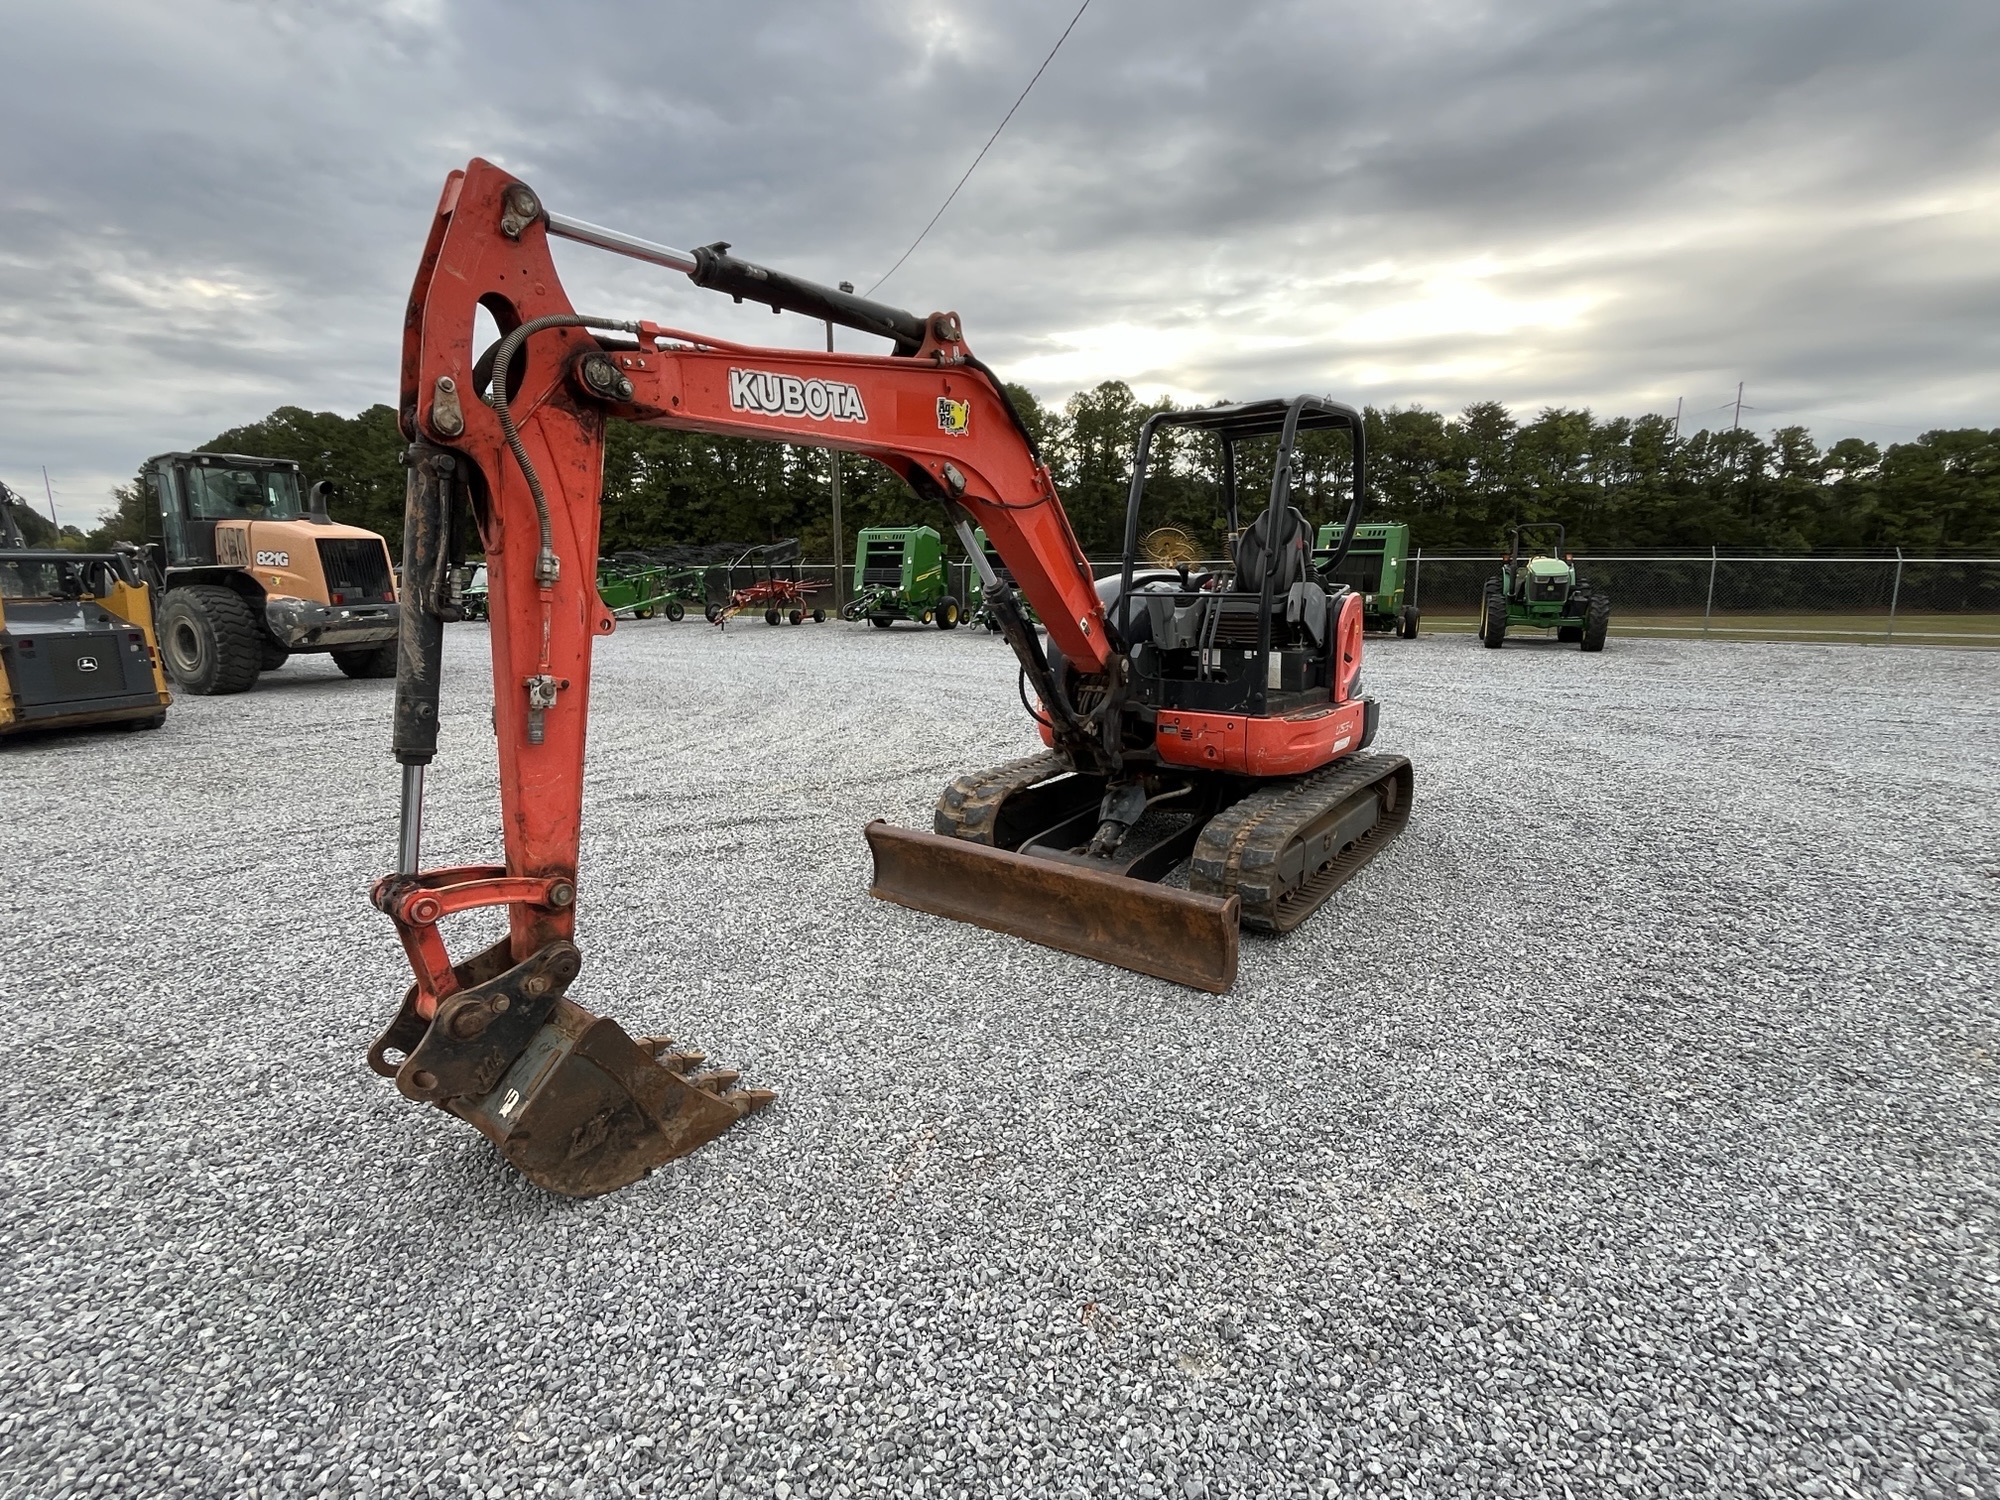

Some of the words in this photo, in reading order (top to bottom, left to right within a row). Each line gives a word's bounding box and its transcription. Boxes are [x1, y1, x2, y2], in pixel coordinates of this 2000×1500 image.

[729, 370, 866, 421] KUBOTA
[940, 413, 955, 426] Pro
[256, 551, 289, 567] 821G
